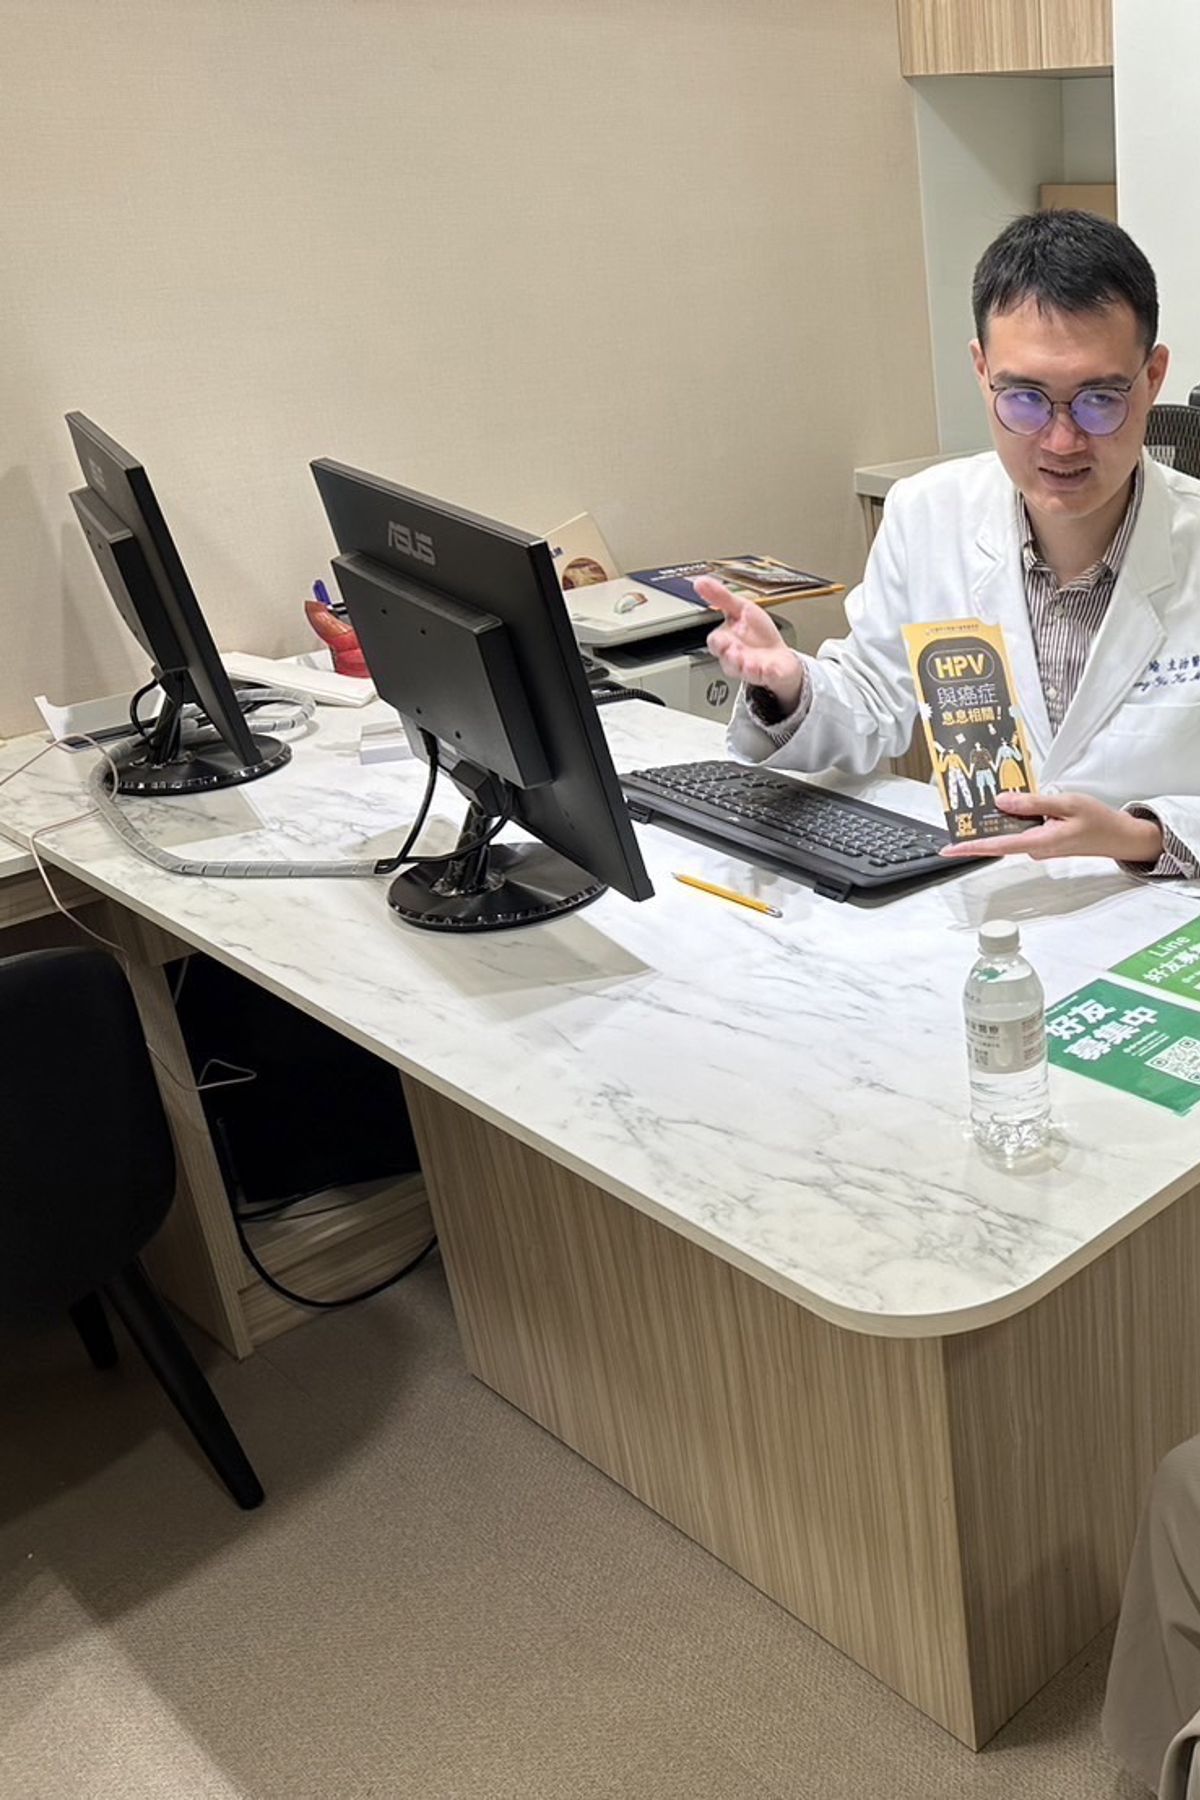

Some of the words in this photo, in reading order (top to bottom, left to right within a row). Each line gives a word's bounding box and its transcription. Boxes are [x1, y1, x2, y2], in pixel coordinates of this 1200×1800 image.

[388, 520, 436, 566] ASUS
[934, 653, 984, 679] HPV
[707, 680, 729, 707] hp
[937, 683, 999, 709] 與癌症
[1148, 936, 1191, 958] Line
[1044, 998, 1117, 1040] 好友
[1063, 1006, 1158, 1060] 募集中
